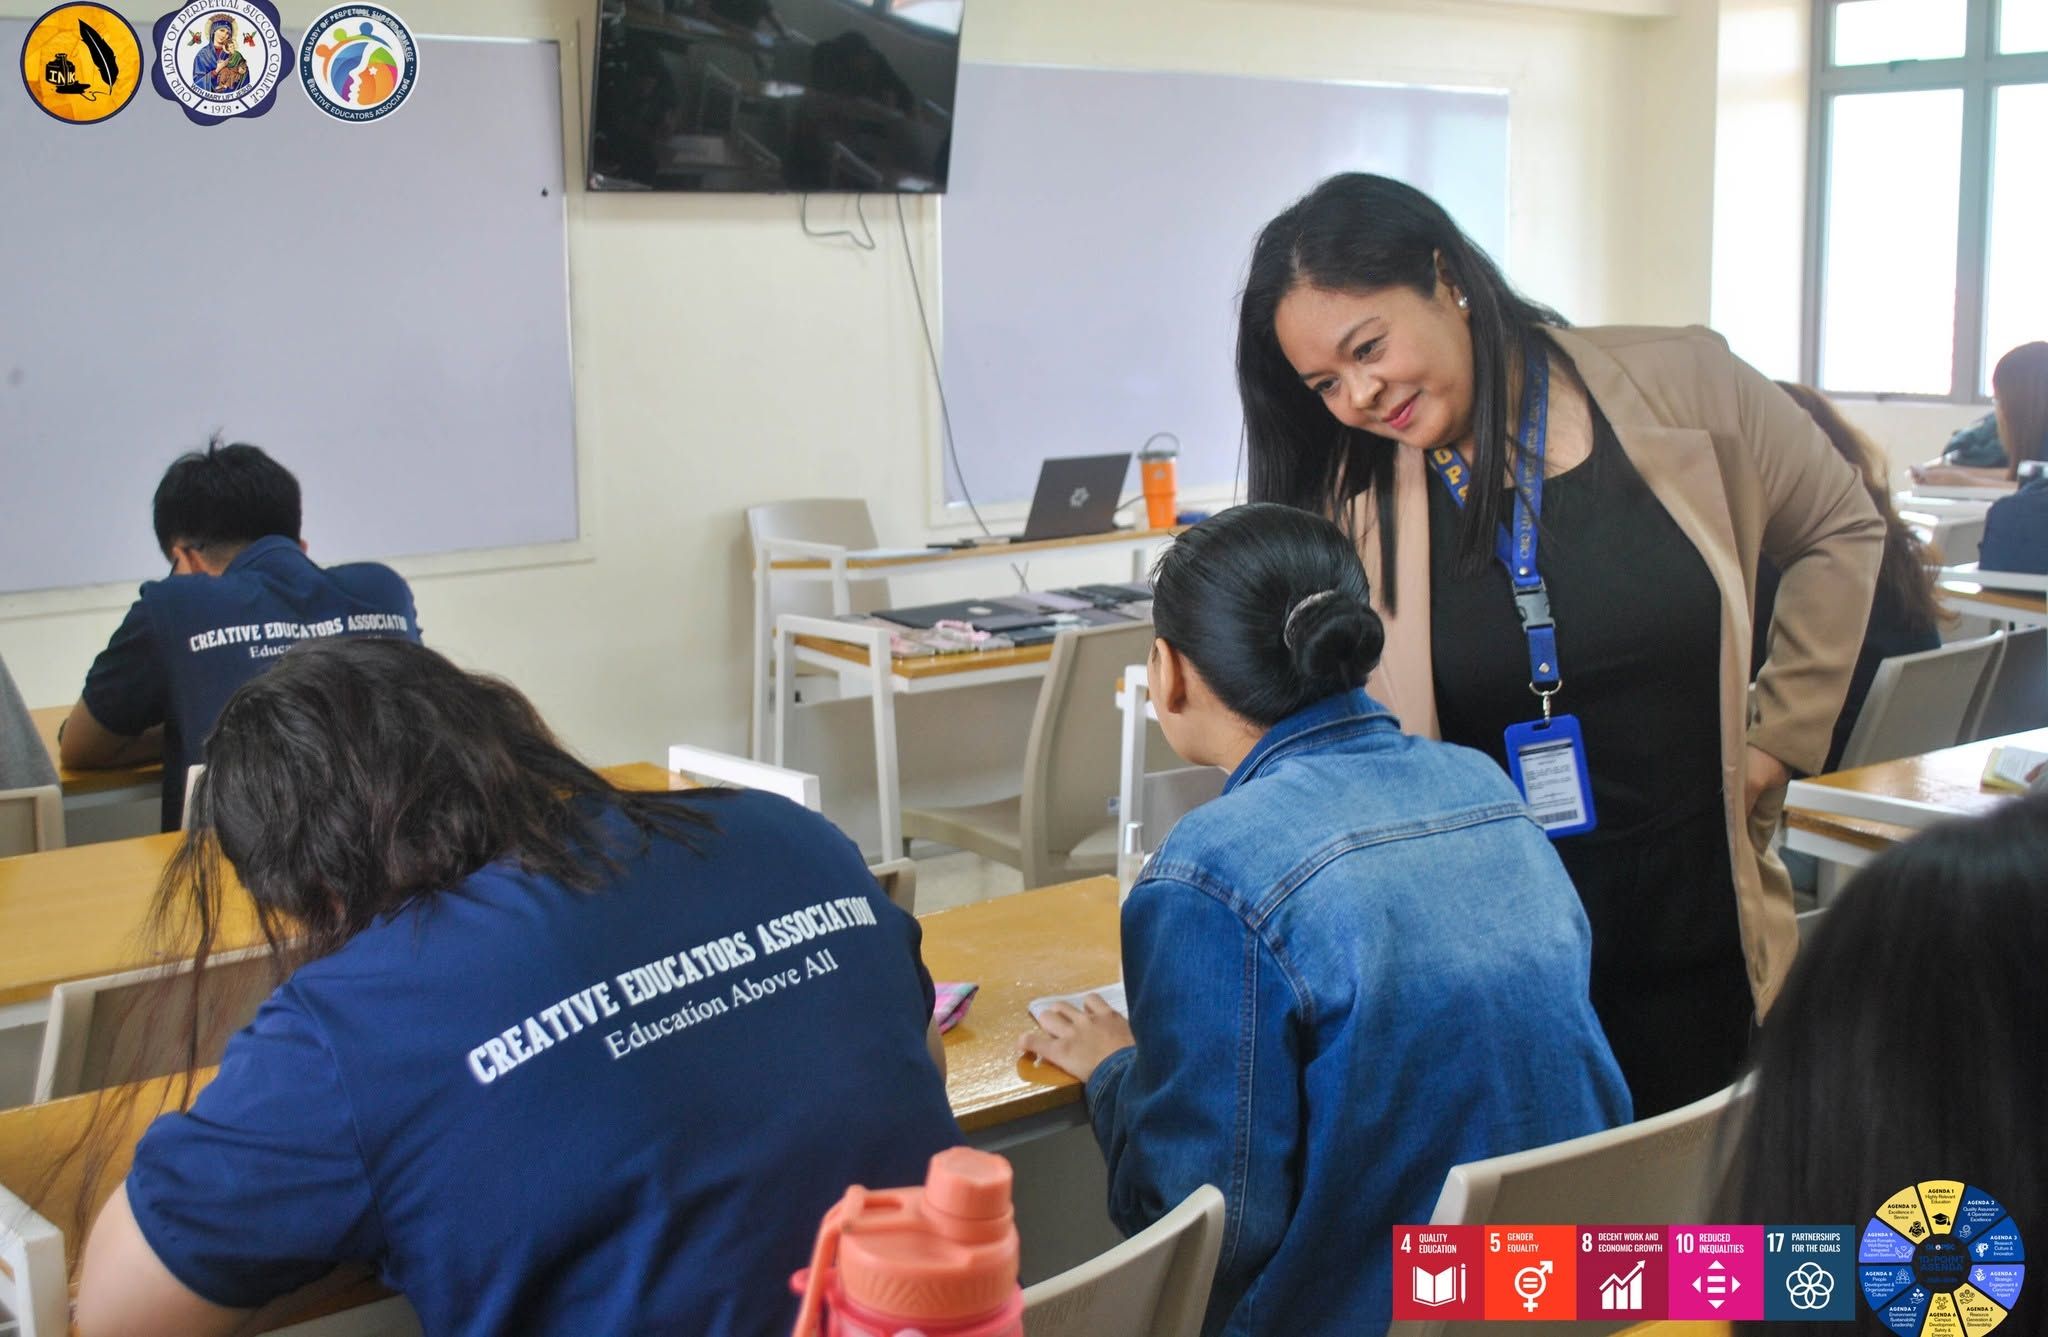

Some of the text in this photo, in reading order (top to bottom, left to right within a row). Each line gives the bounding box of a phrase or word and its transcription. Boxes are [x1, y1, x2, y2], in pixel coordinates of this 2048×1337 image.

[190, 624, 261, 652] CREATIVE
[264, 618, 344, 639] EDUCATORS
[466, 896, 878, 1084] CREATIVE EDUCATORS ASSOCIATION
[604, 948, 839, 1060] Education Above All
